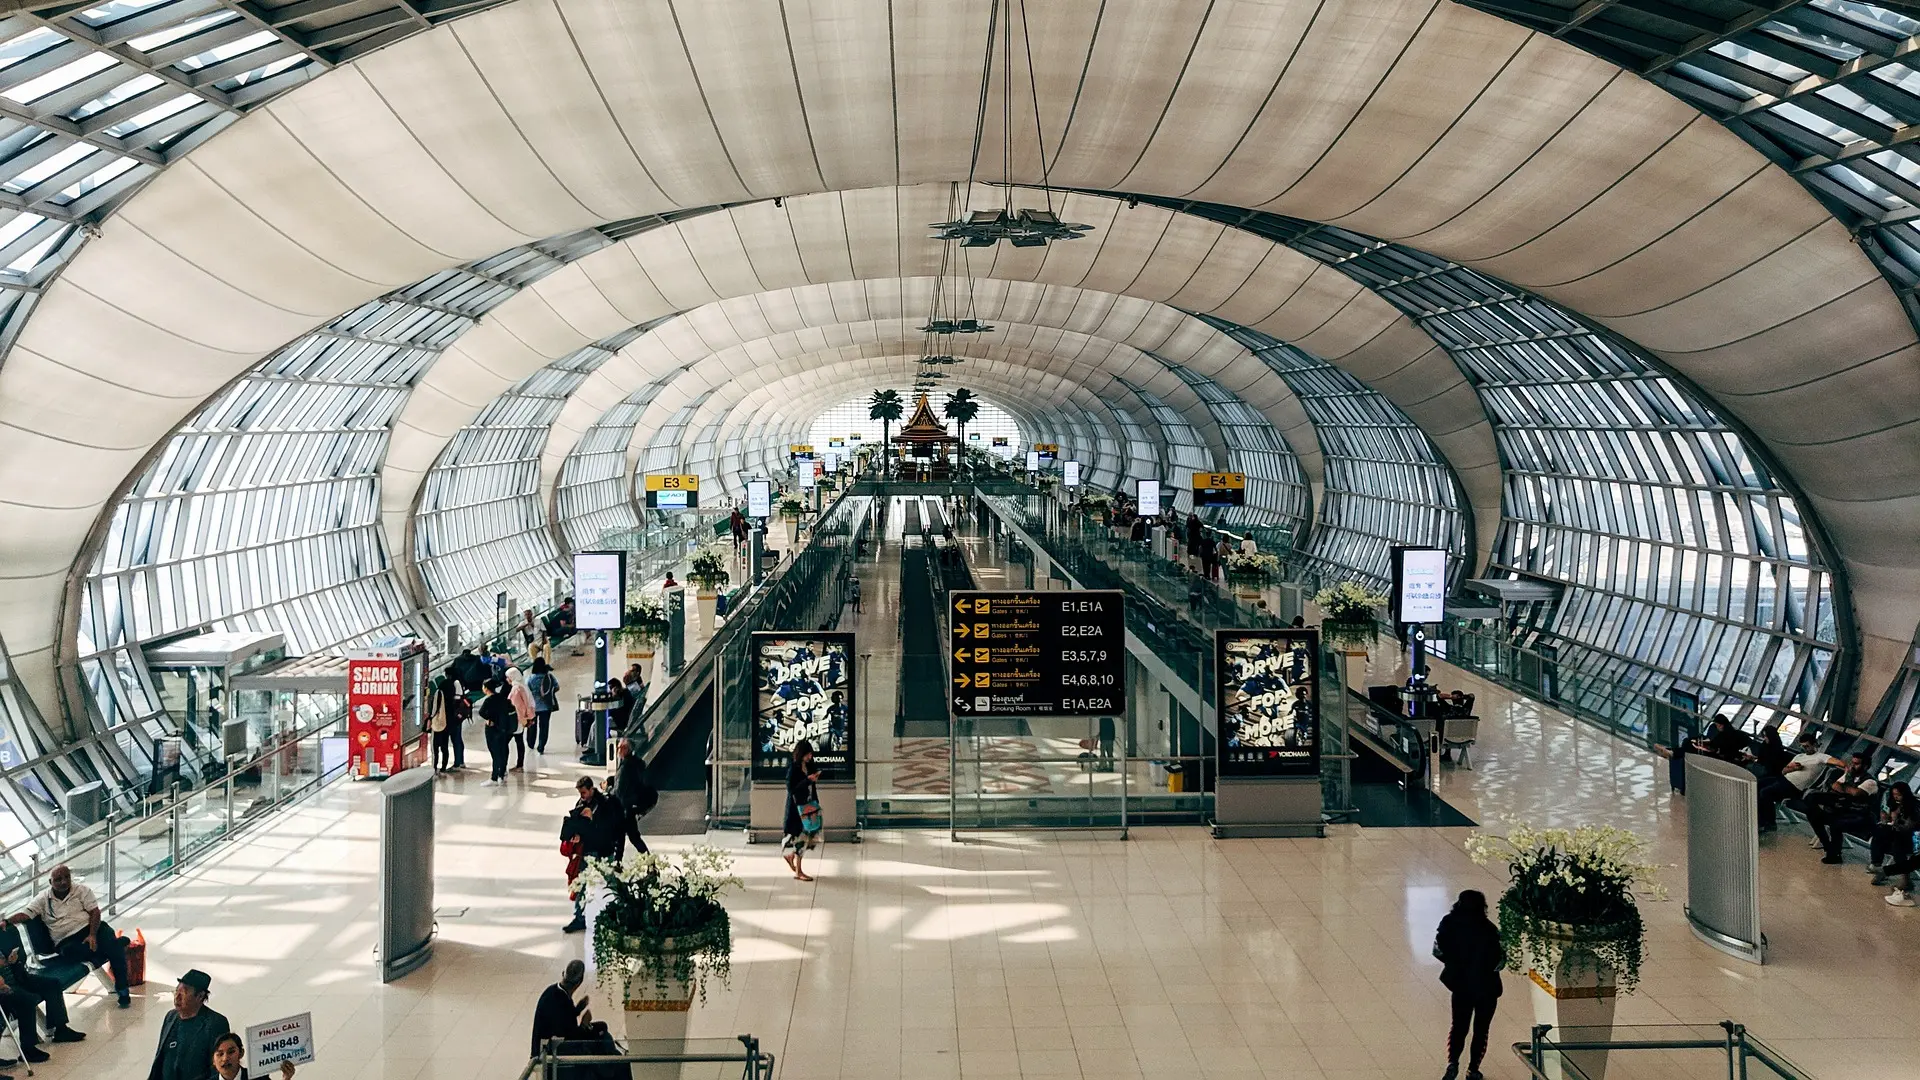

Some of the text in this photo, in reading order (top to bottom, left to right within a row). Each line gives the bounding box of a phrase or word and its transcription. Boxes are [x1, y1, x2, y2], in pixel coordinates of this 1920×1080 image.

[664, 478, 680, 488] E3
[1210, 476, 1226, 486] E4
[1062, 602, 1103, 613] E1,E1A
[1062, 626, 1102, 637] E2,E2A
[1062, 650, 1106, 662] E3,5,7,9
[776, 655, 830, 684] DRIVE
[1240, 651, 1294, 680] DRIVE
[353, 666, 398, 682] SNACK
[1062, 674, 1114, 686] E4,6,8,10
[1062, 698, 1112, 710] E1A,E2A
[780, 719, 829, 745] MORE
[1245, 714, 1294, 740] MORE
[259, 1022, 300, 1037] FINAL CALL
[262, 1036, 299, 1052] NH848
